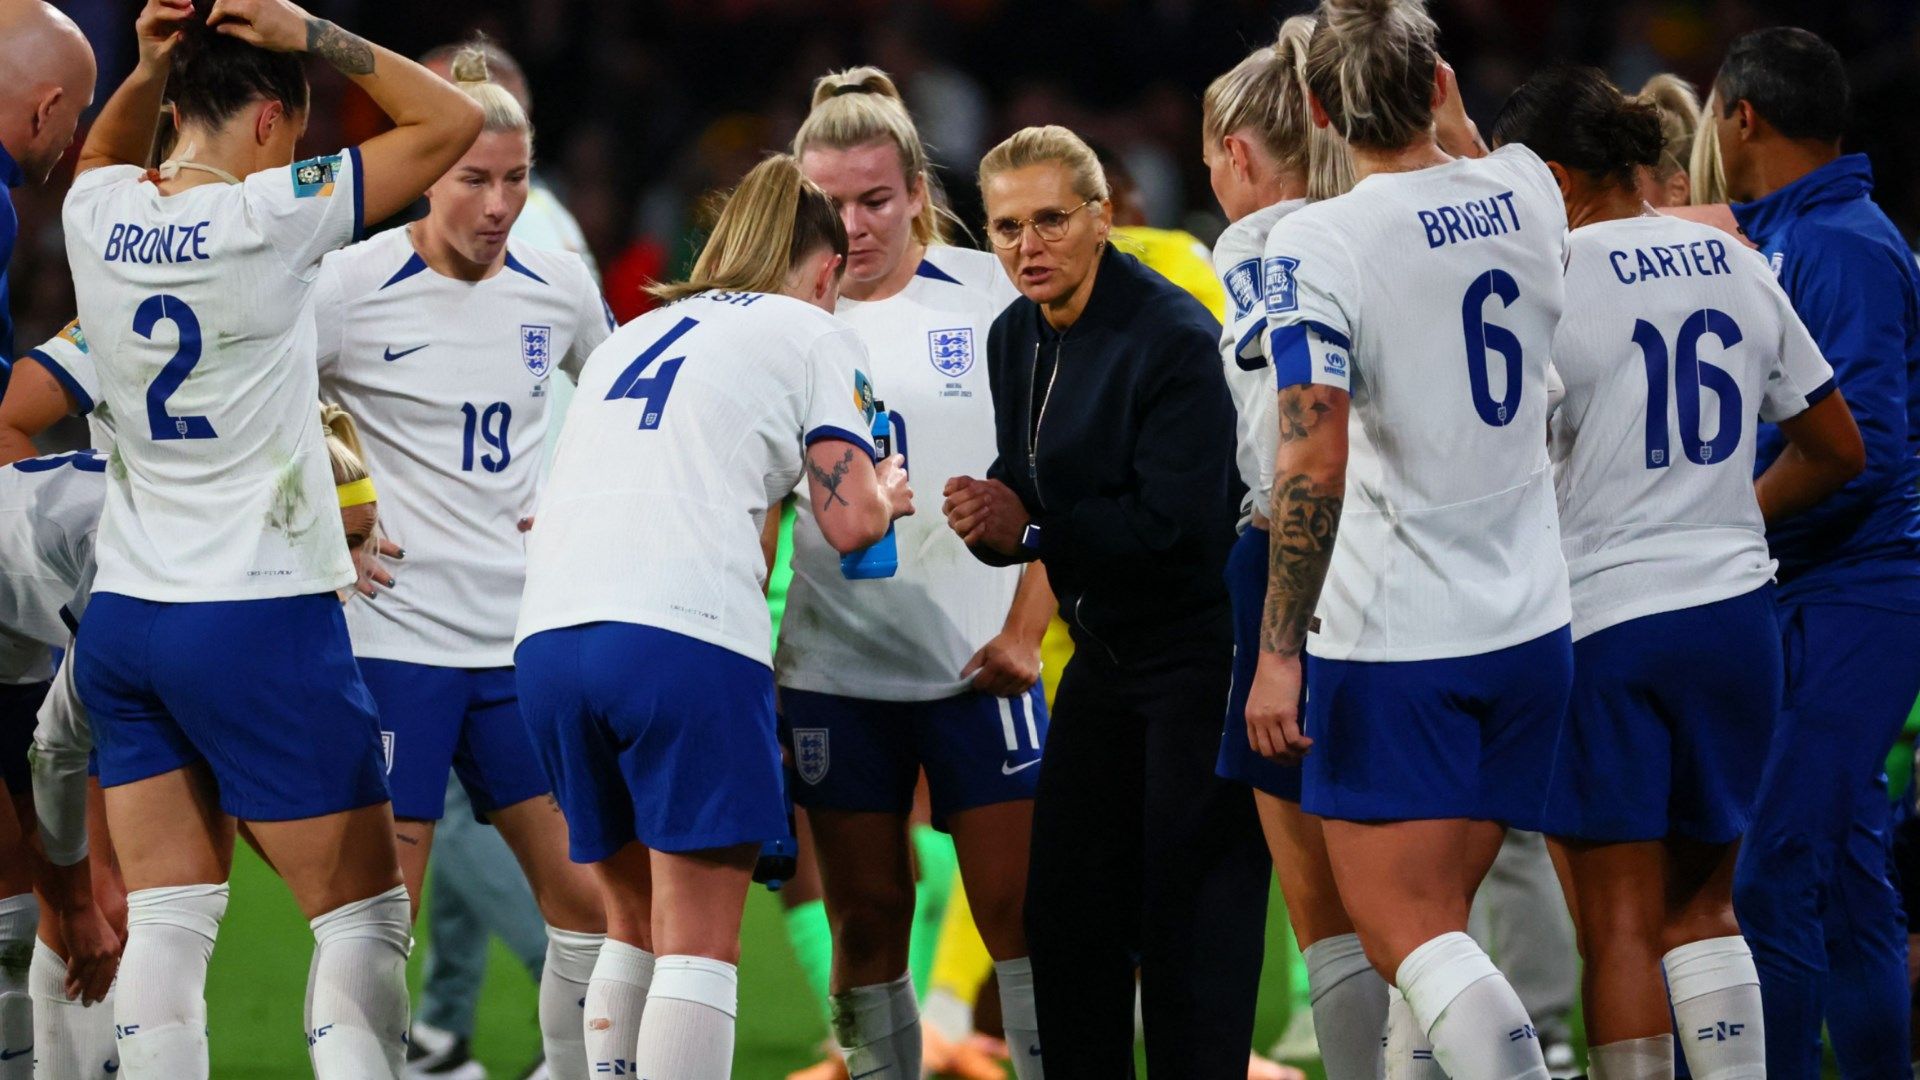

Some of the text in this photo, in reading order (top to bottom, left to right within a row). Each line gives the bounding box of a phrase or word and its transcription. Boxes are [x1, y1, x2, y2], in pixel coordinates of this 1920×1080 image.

[104, 221, 210, 264] BRONZE
[1417, 191, 1522, 249] BRIGHT
[1609, 239, 1732, 284] CARTER
[132, 294, 218, 440] 2
[604, 316, 699, 430] 4
[1462, 269, 1523, 427] 6
[1631, 308, 1743, 469] 16
[461, 401, 512, 473] 19
[996, 691, 1040, 751] 11
